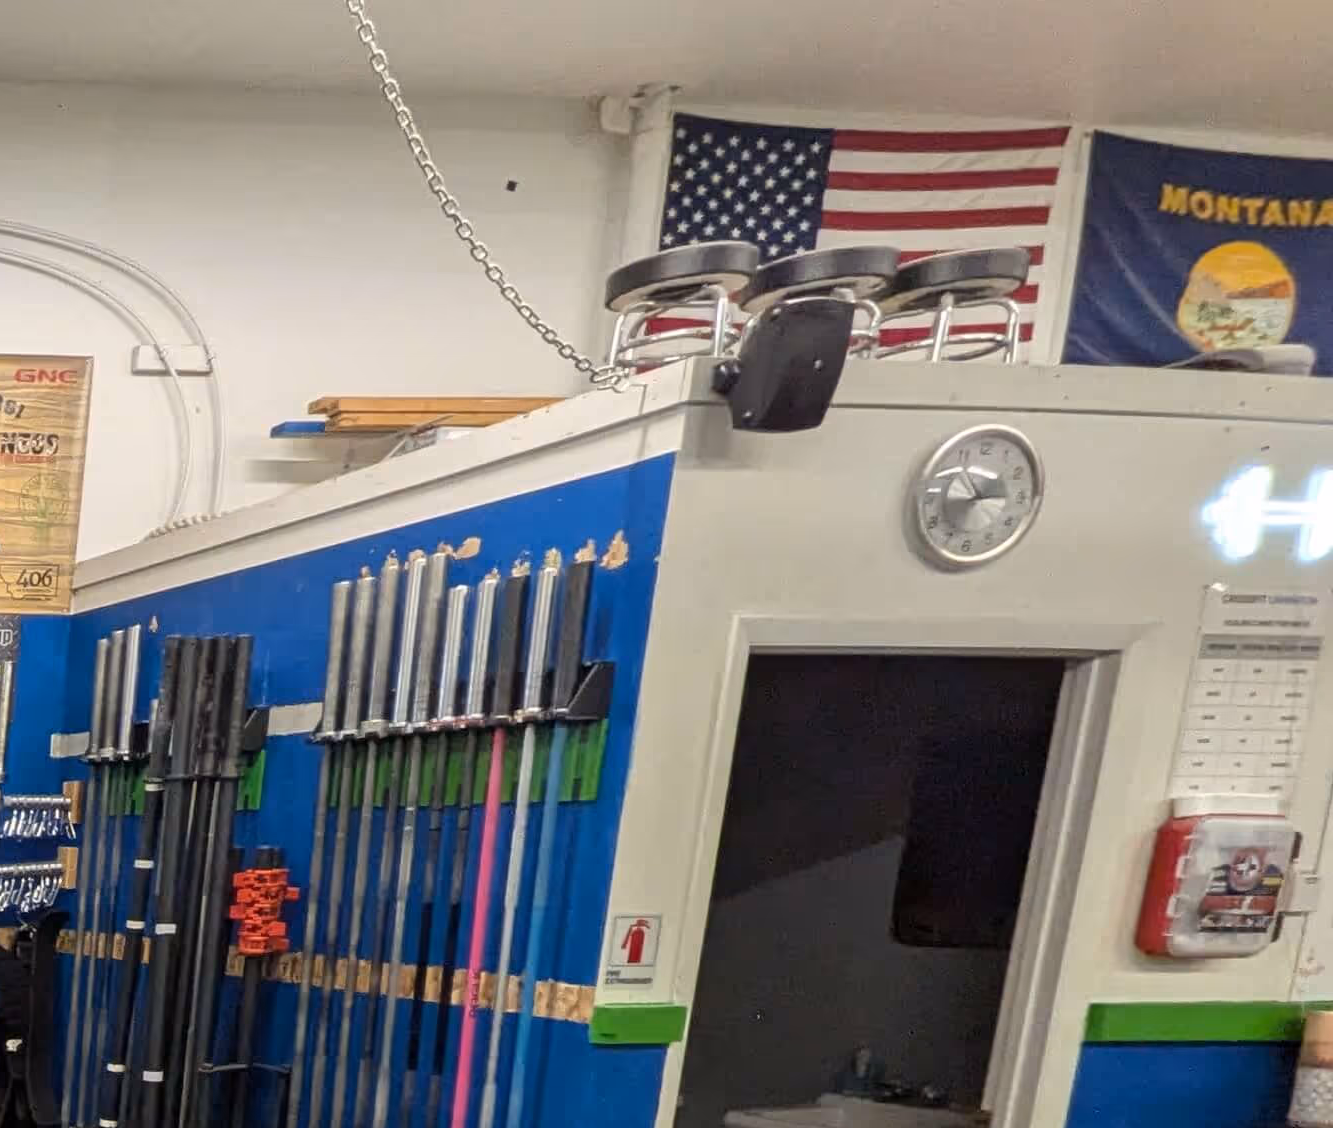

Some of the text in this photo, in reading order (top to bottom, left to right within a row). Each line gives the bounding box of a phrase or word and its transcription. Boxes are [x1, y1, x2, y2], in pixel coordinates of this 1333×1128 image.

[1158, 182, 1333, 228] MONTANA
[14, 368, 78, 384] GNC
[16, 568, 53, 588] 406
